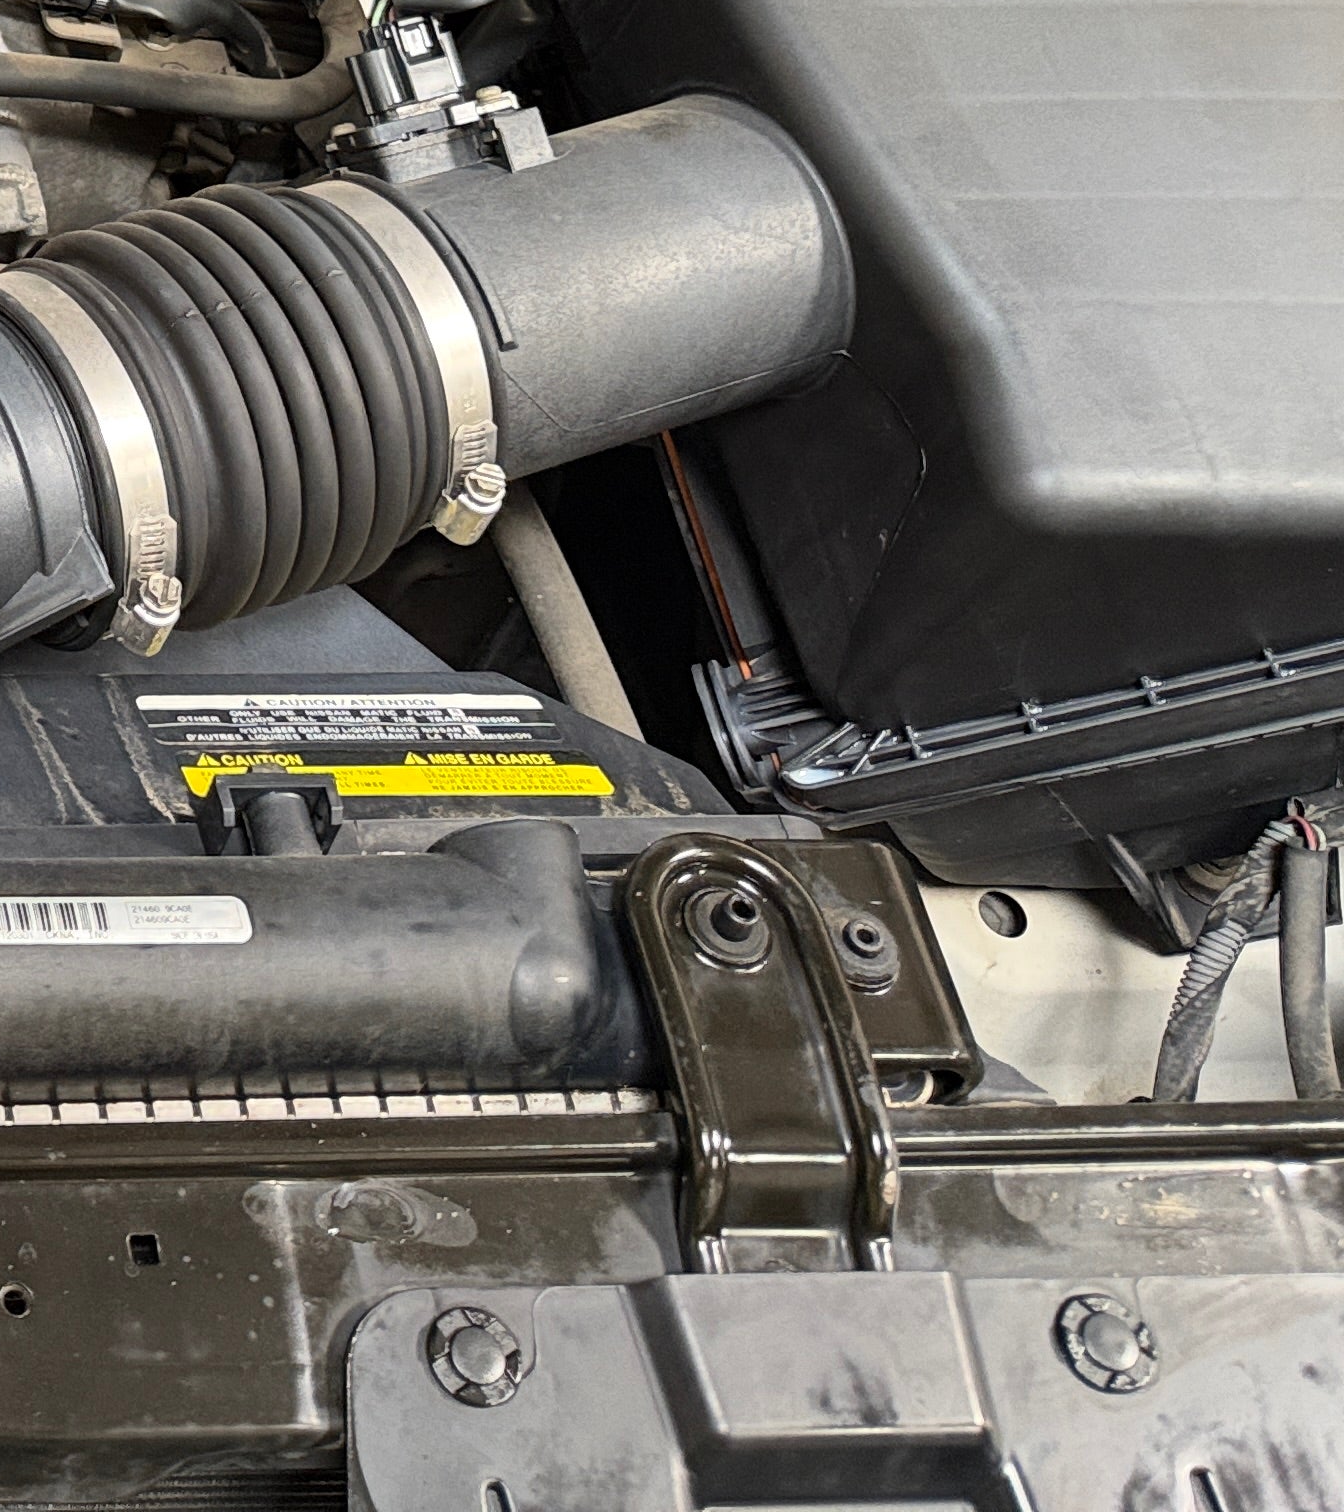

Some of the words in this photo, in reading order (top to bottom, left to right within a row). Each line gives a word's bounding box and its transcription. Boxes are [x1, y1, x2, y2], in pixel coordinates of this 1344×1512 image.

[265, 699, 338, 707] CAUTION
[231, 716, 276, 724] FLUIDS
[220, 753, 304, 767] CAUTION
[426, 753, 469, 765] MISE
[468, 753, 496, 765] EN
[495, 753, 556, 765] GARDE
